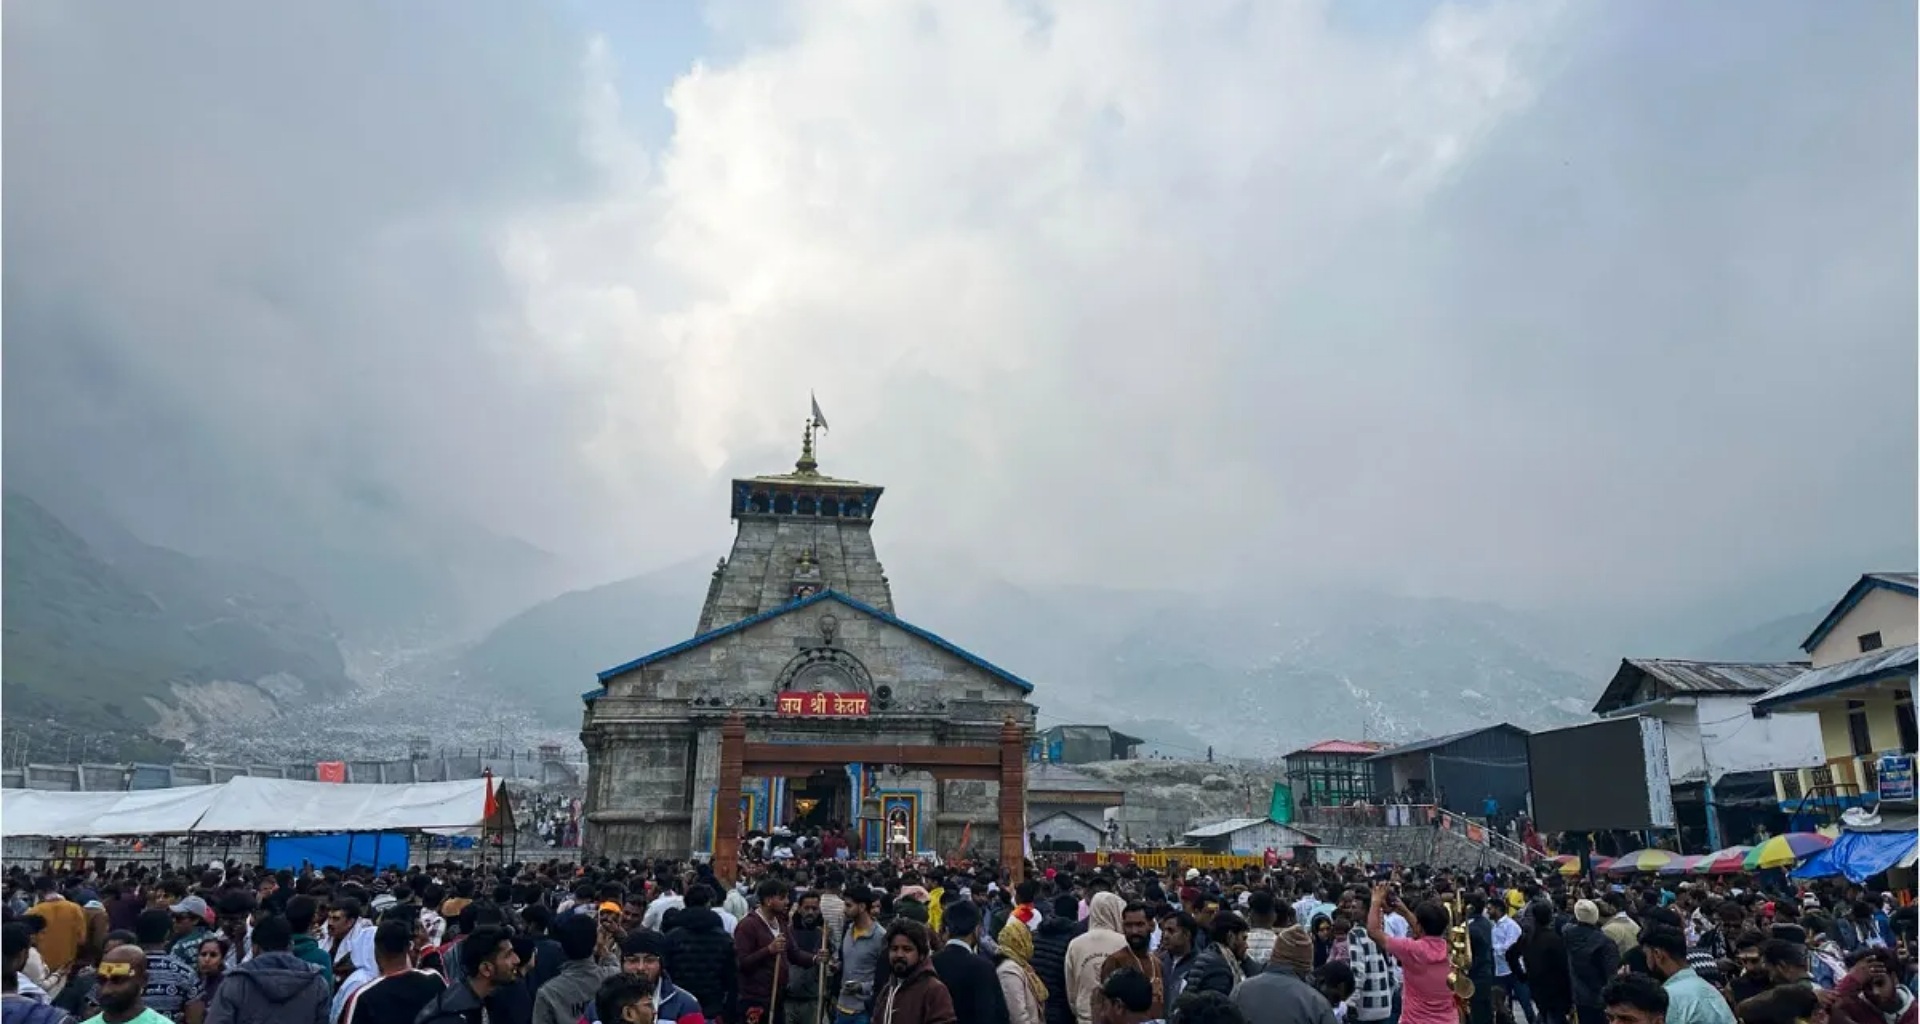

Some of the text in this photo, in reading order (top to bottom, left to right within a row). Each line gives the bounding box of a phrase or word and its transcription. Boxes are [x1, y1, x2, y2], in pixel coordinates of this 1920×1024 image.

[780, 692, 867, 715] जय श्री केदार
